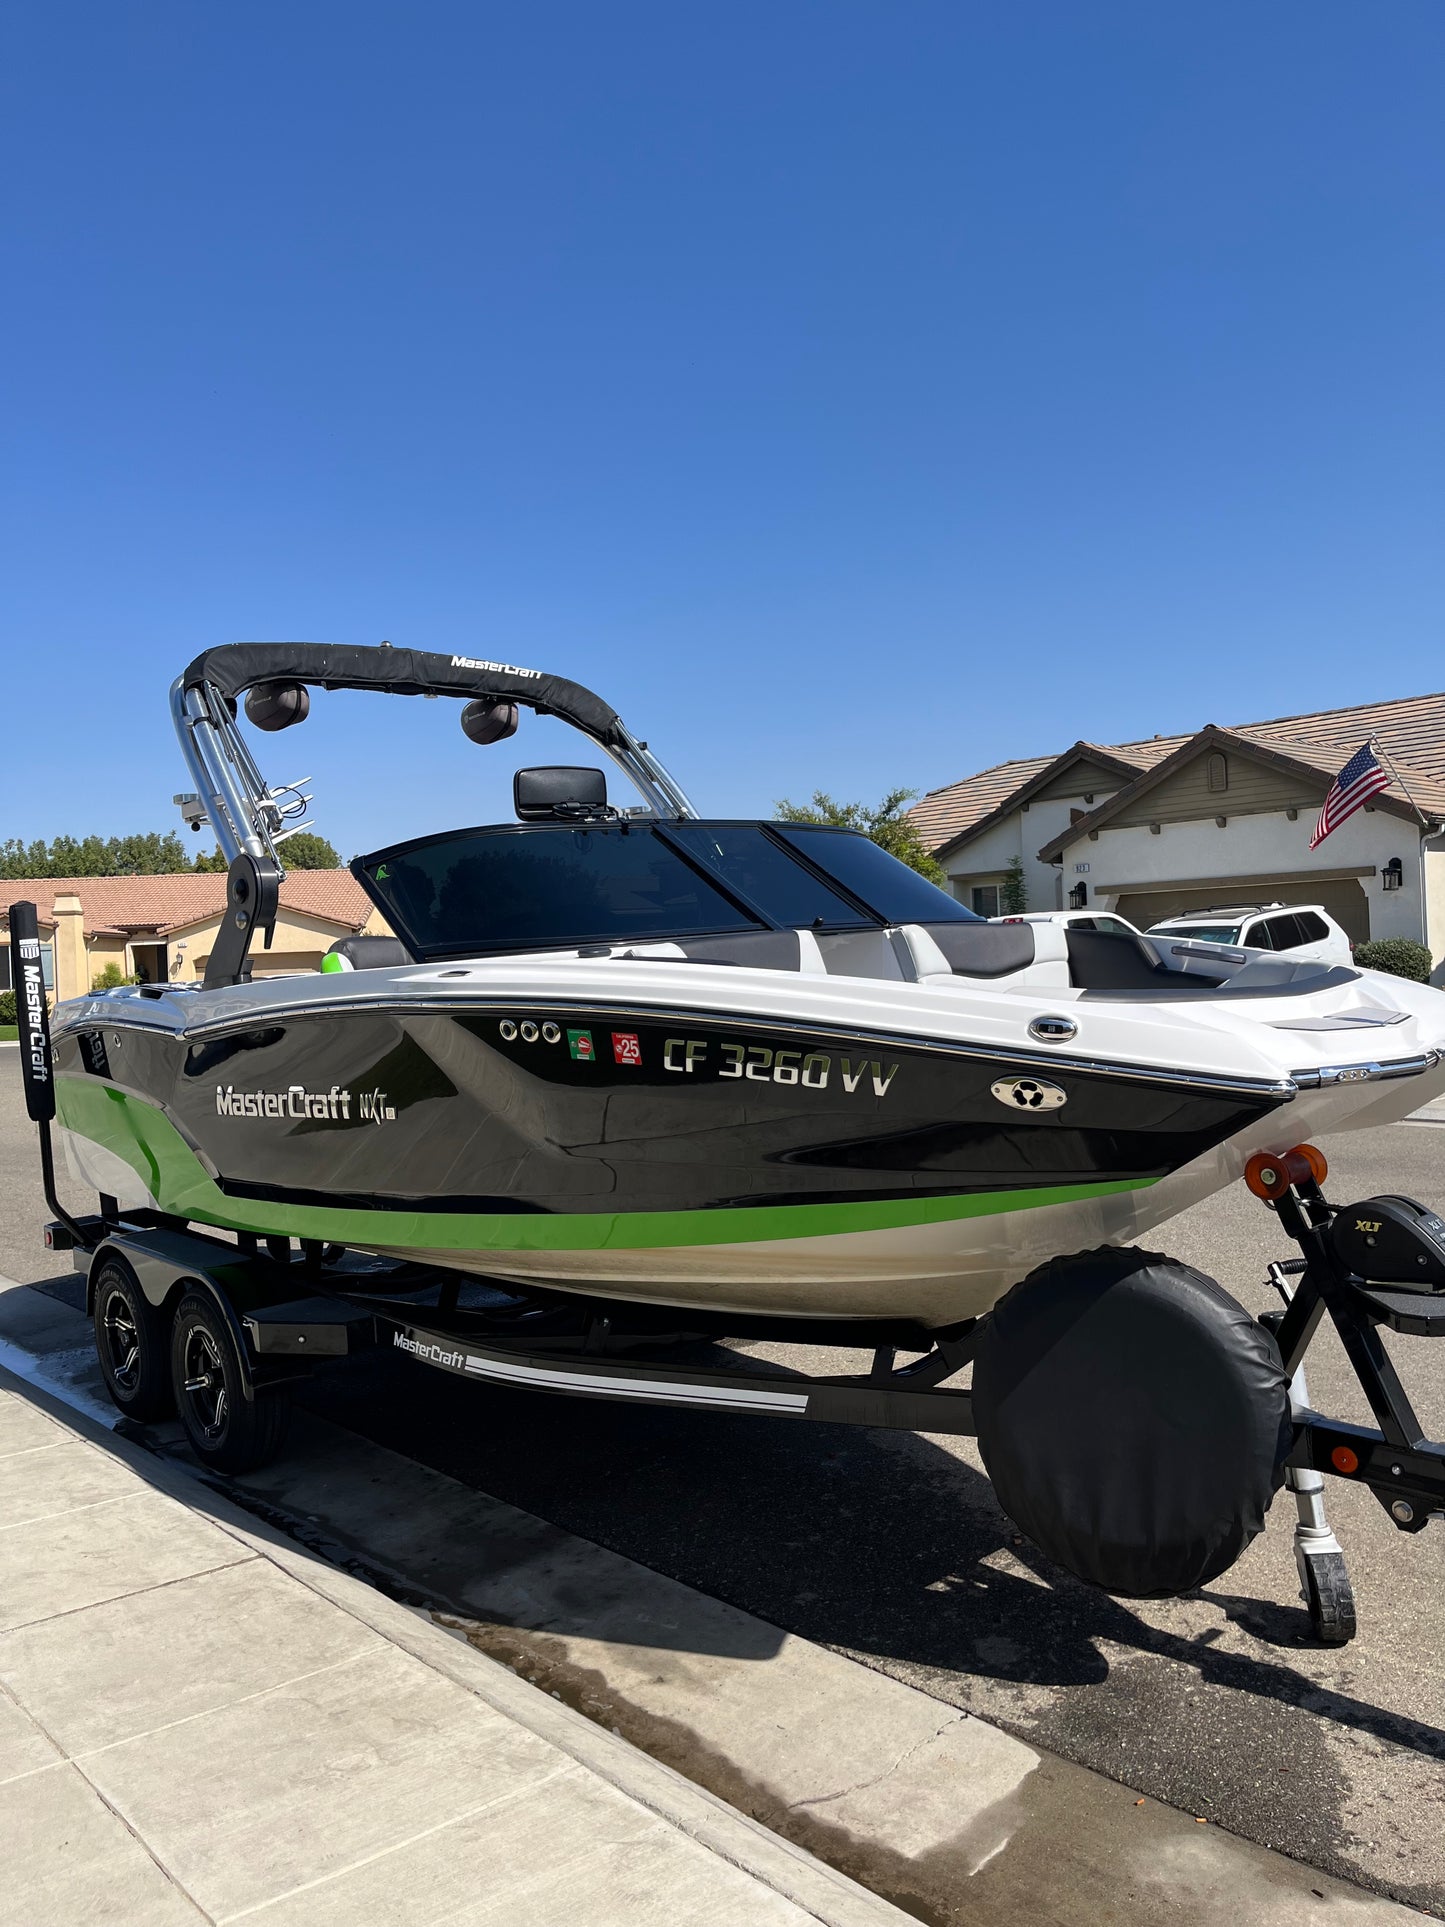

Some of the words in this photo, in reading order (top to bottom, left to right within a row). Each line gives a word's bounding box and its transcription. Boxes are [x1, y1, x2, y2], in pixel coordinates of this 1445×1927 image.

[24, 965, 47, 1083] MasterCraft
[621, 1039, 640, 1058] 25
[664, 1039, 707, 1073] CF
[718, 1043, 831, 1089] 3260
[840, 1057, 900, 1097] VV
[216, 1085, 351, 1120] MasterCraft
[1354, 1219, 1383, 1233] XLT
[393, 1331, 464, 1368] MasterCraft
